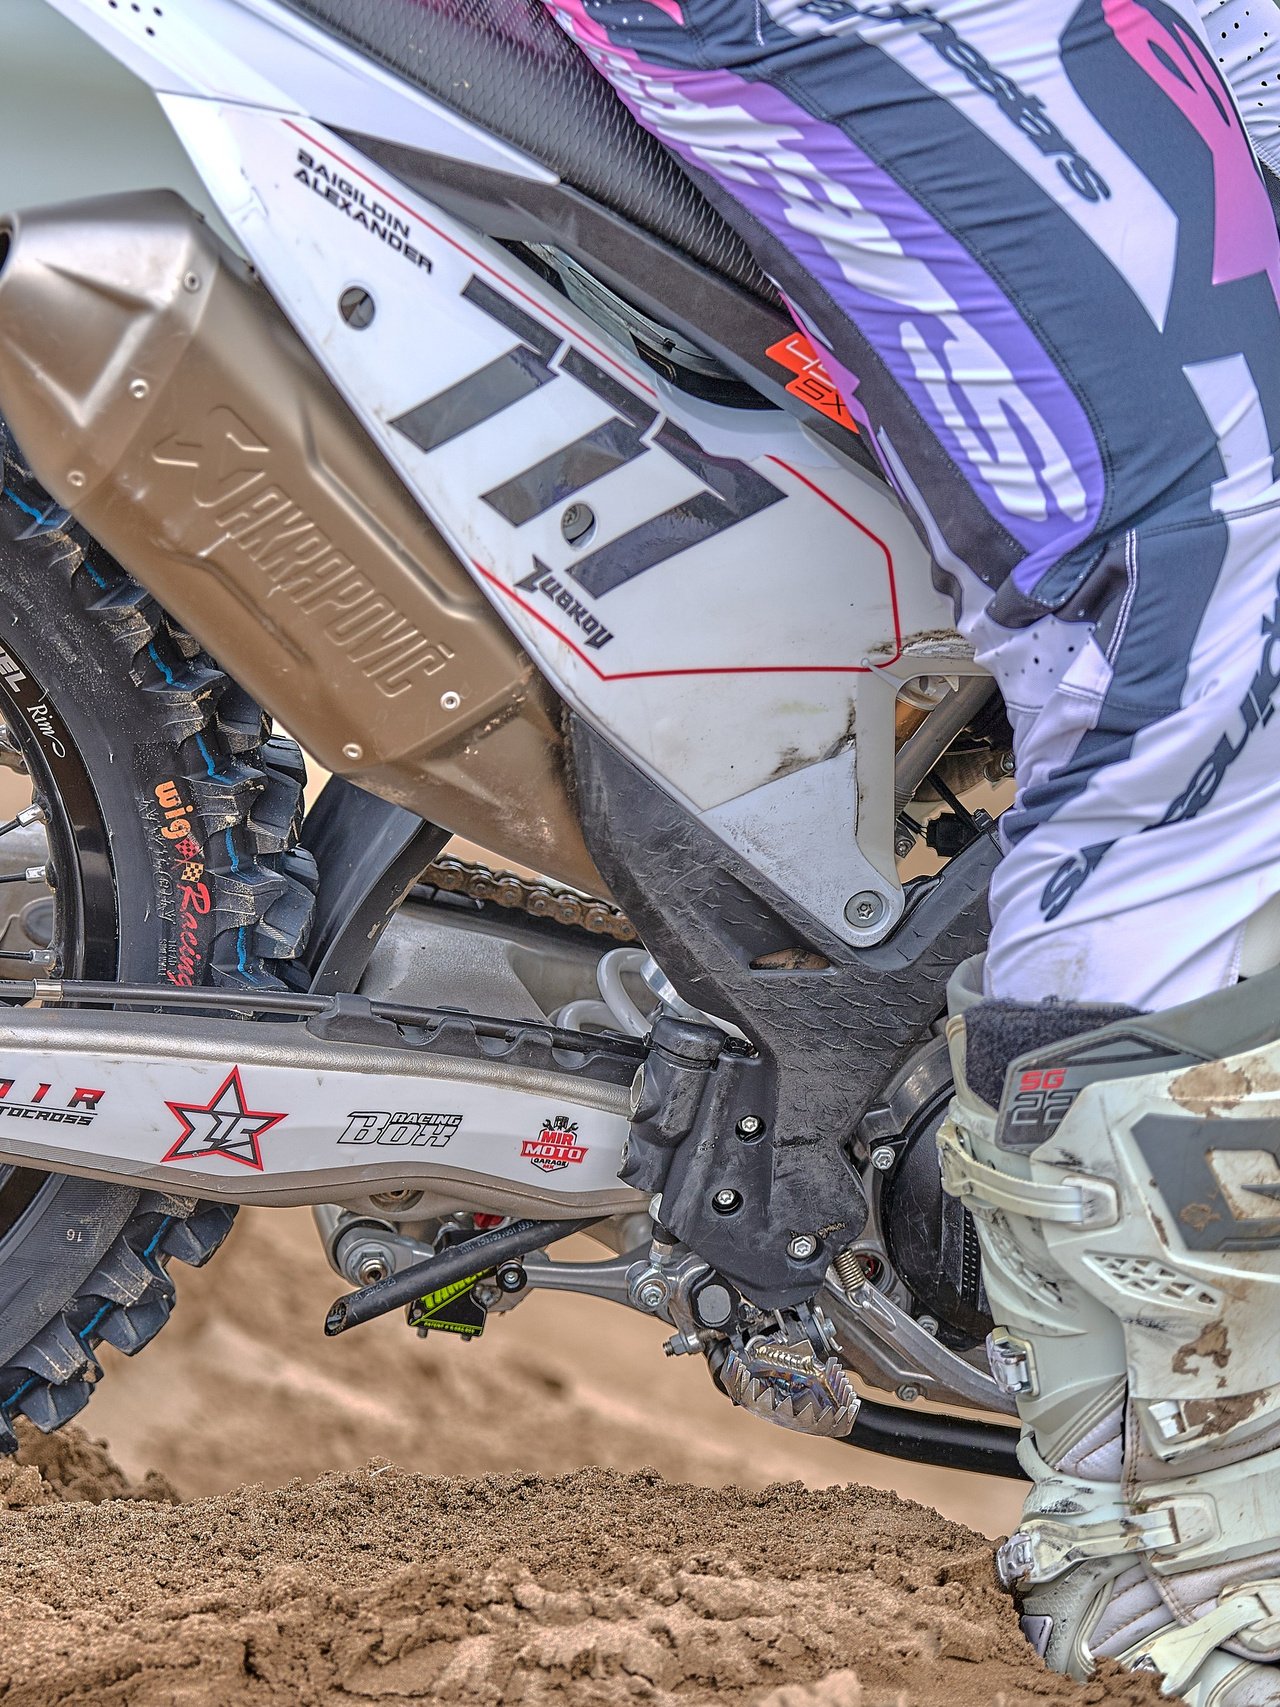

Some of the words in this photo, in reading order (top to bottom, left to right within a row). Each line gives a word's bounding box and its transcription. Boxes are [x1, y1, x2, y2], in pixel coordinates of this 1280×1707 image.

[297, 148, 410, 240] BAIGILDIN
[294, 168, 434, 275] ALEXANDER
[795, 378, 846, 416] SX
[26, 703, 66, 758] Rim
[154, 780, 195, 840] wig
[1019, 1068, 1067, 1092] SG
[391, 1112, 463, 1126] RACING
[1010, 1087, 1082, 1126] 22
[524, 1143, 582, 1159] MOTO
[540, 1130, 575, 1145] MIR
